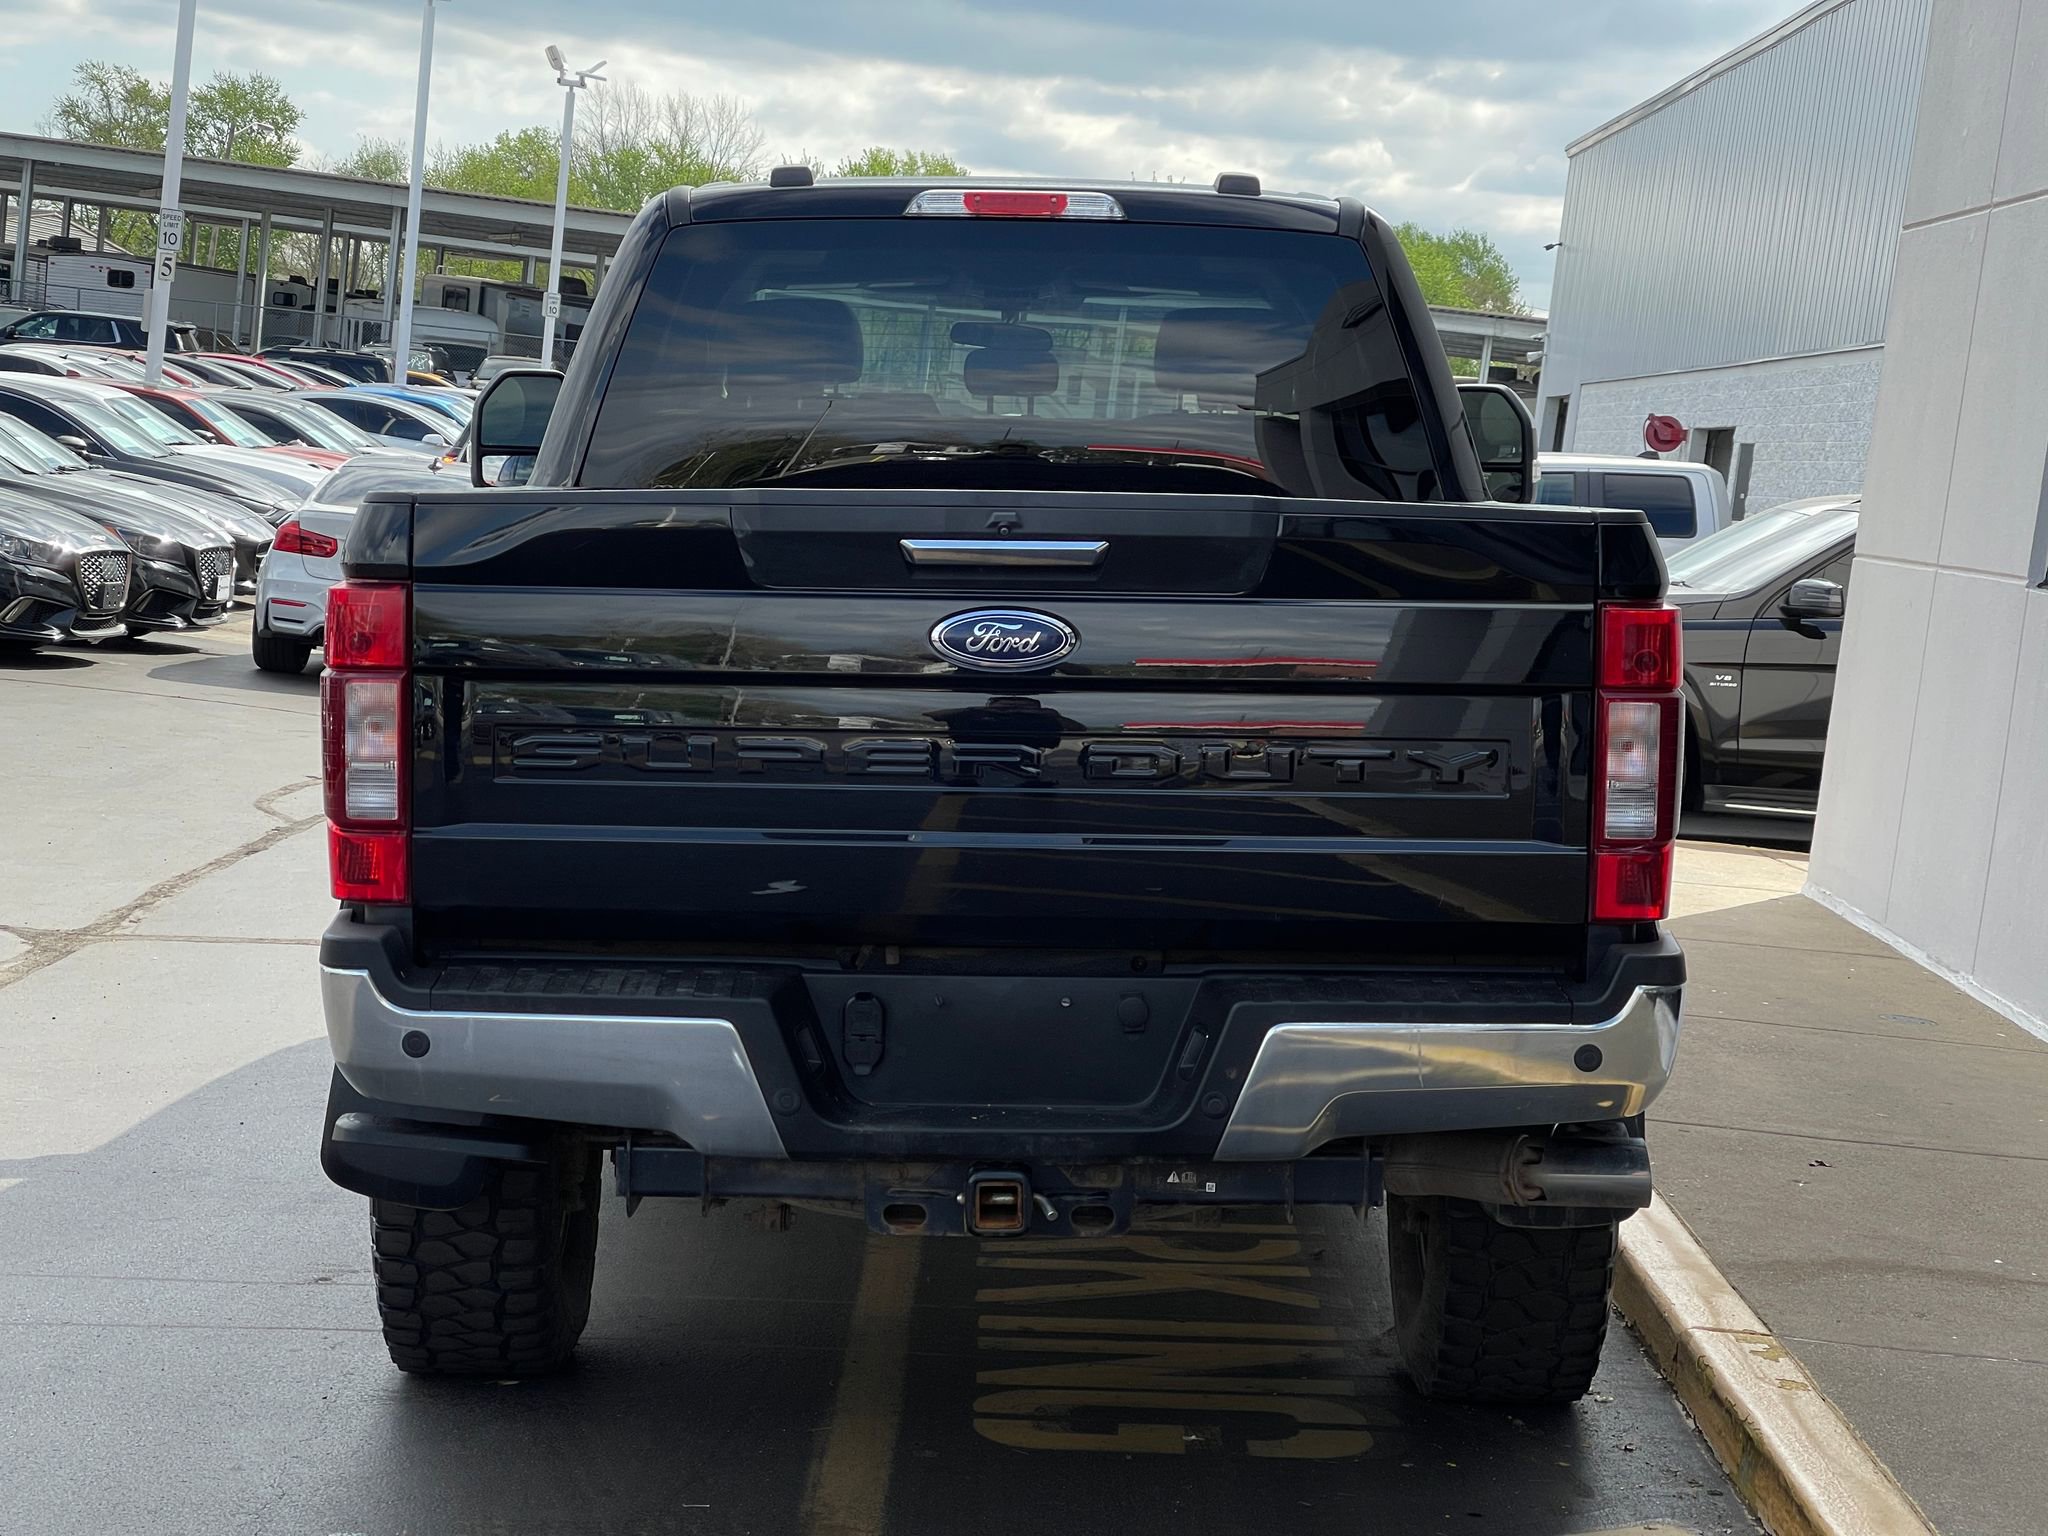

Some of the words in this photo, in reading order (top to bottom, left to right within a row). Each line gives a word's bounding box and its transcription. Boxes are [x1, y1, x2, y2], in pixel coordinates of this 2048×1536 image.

[162, 213, 182, 221] SPEED
[163, 231, 178, 245] 10
[161, 256, 173, 277] 5
[549, 305, 558, 315] 10
[966, 621, 1042, 653] Ford
[511, 734, 1042, 786] SUPER
[1081, 742, 1500, 784] DUTY
